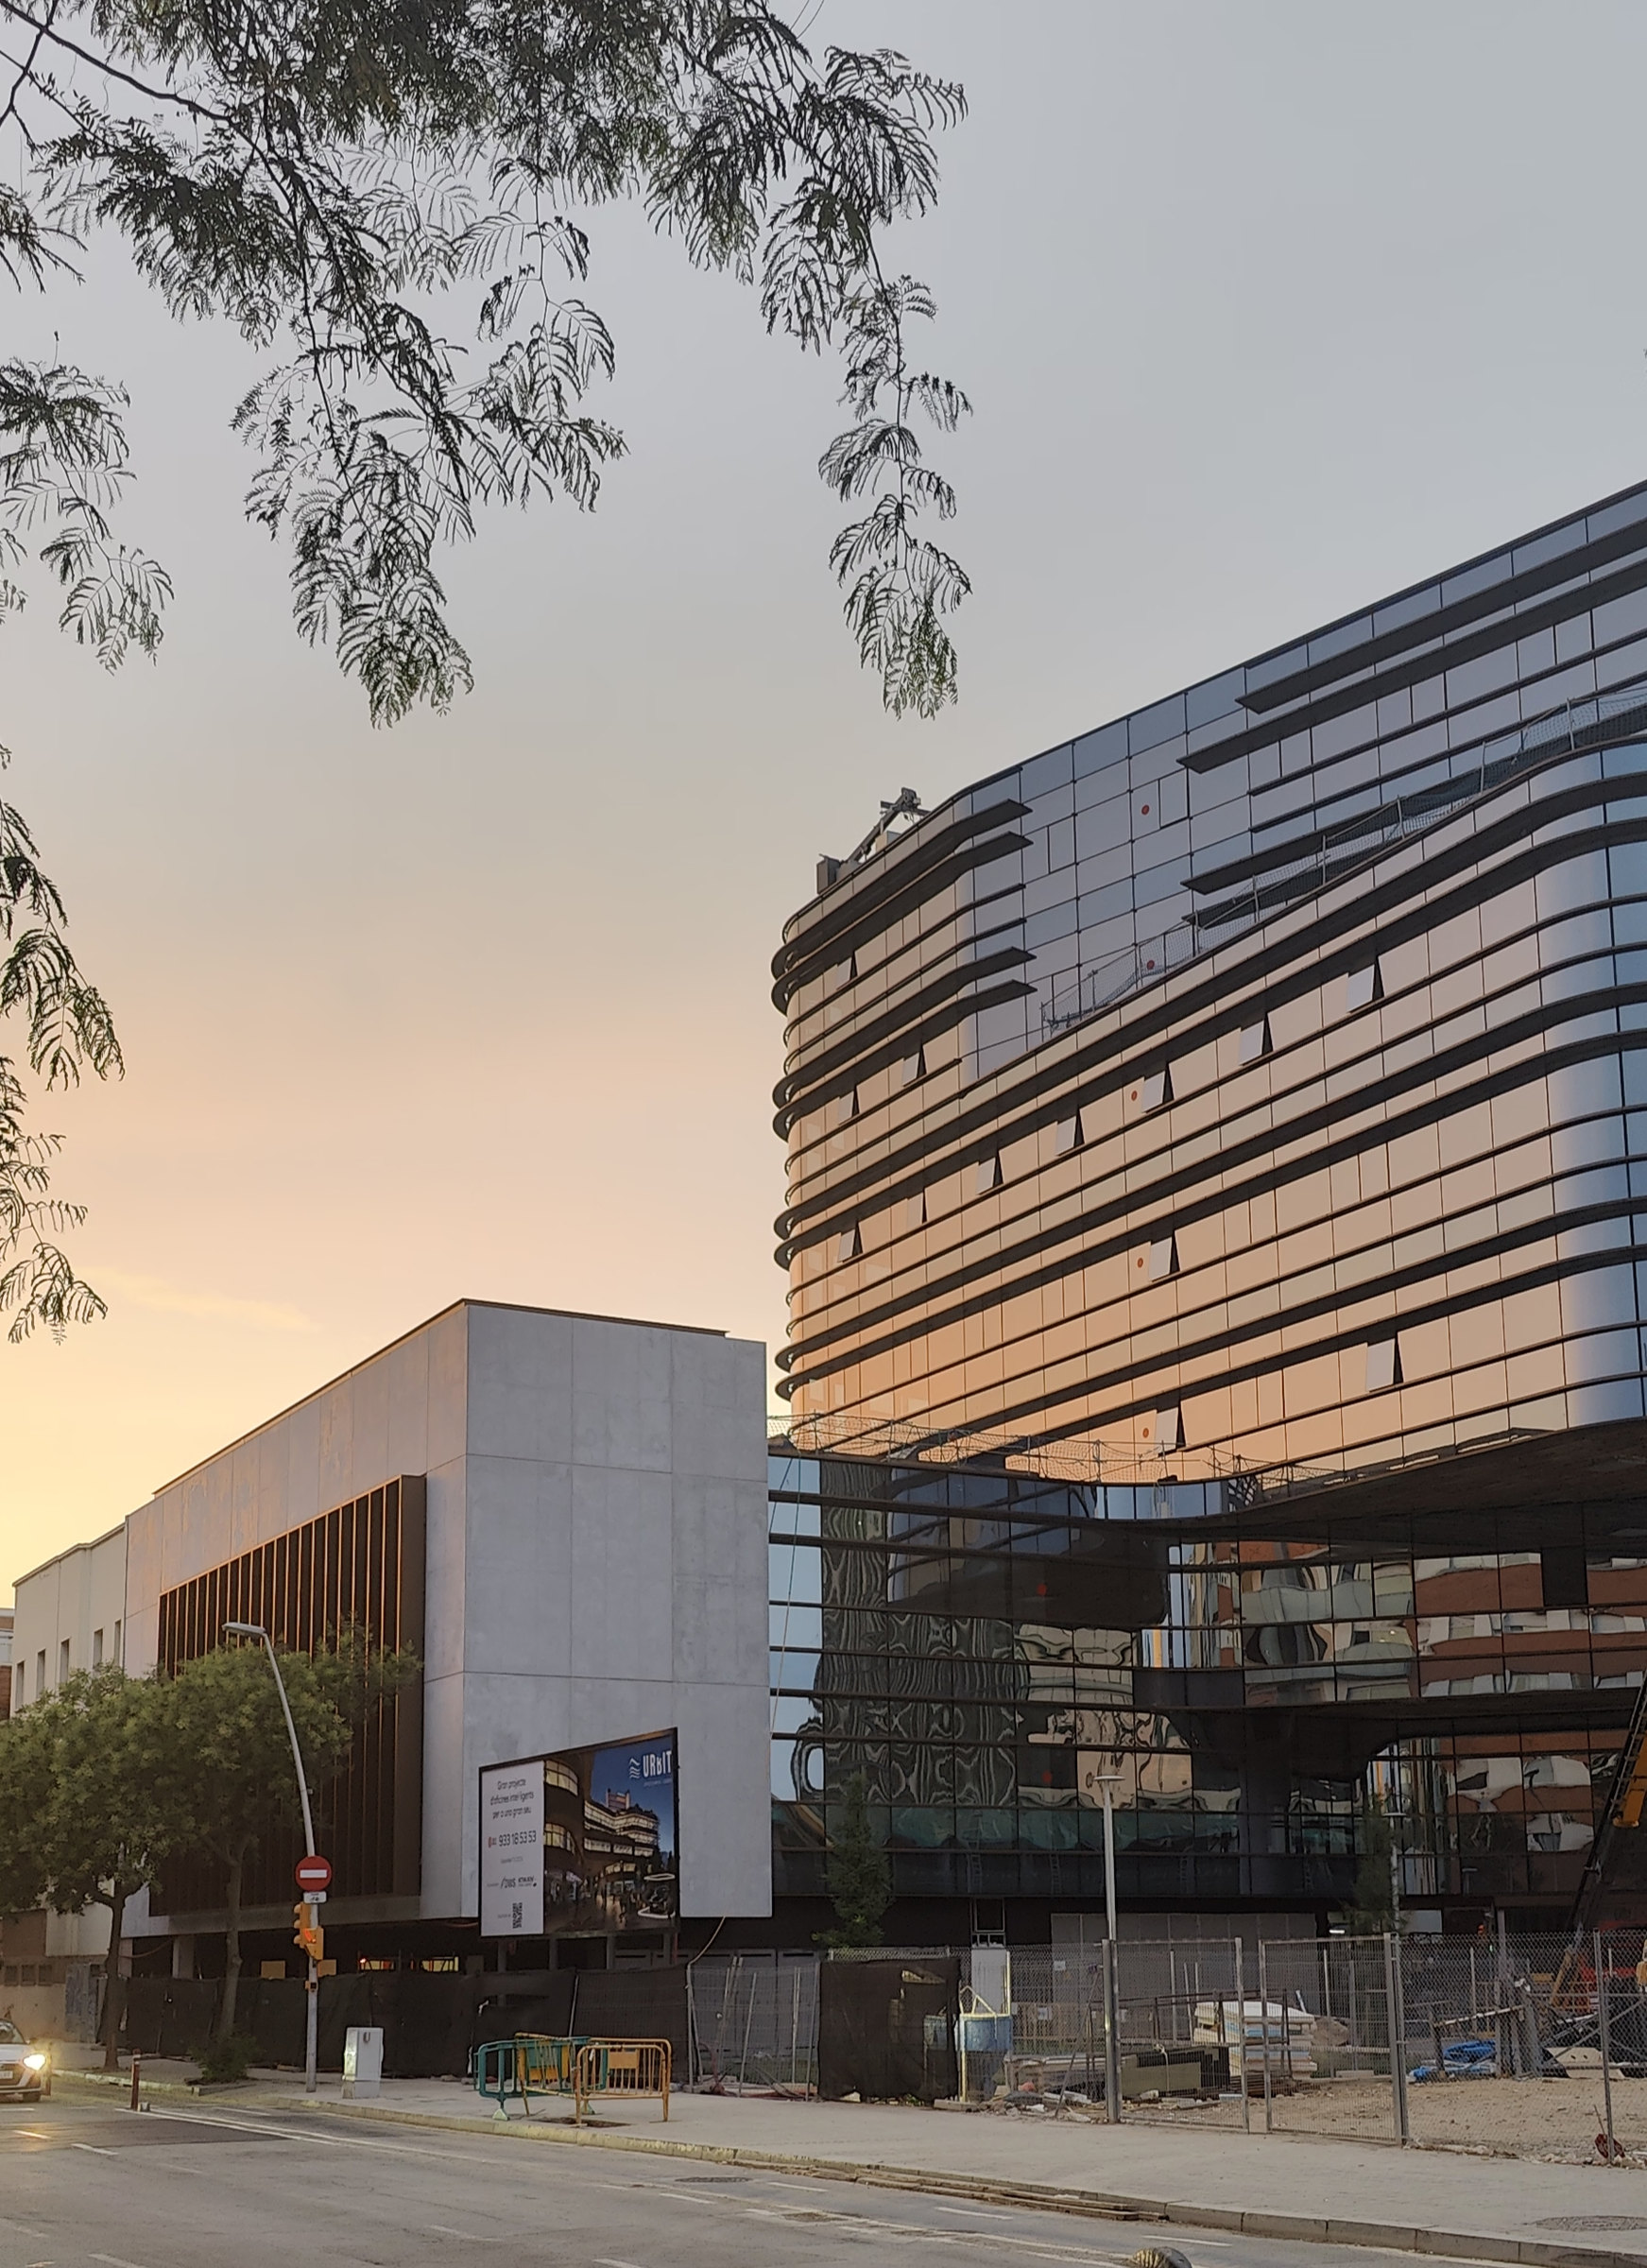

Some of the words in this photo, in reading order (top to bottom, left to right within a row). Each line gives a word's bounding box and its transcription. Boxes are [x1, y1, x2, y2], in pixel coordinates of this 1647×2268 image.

[499, 1833, 510, 1847] 933
[520, 1831, 527, 1844] 53
[528, 1830, 537, 1843] 53
